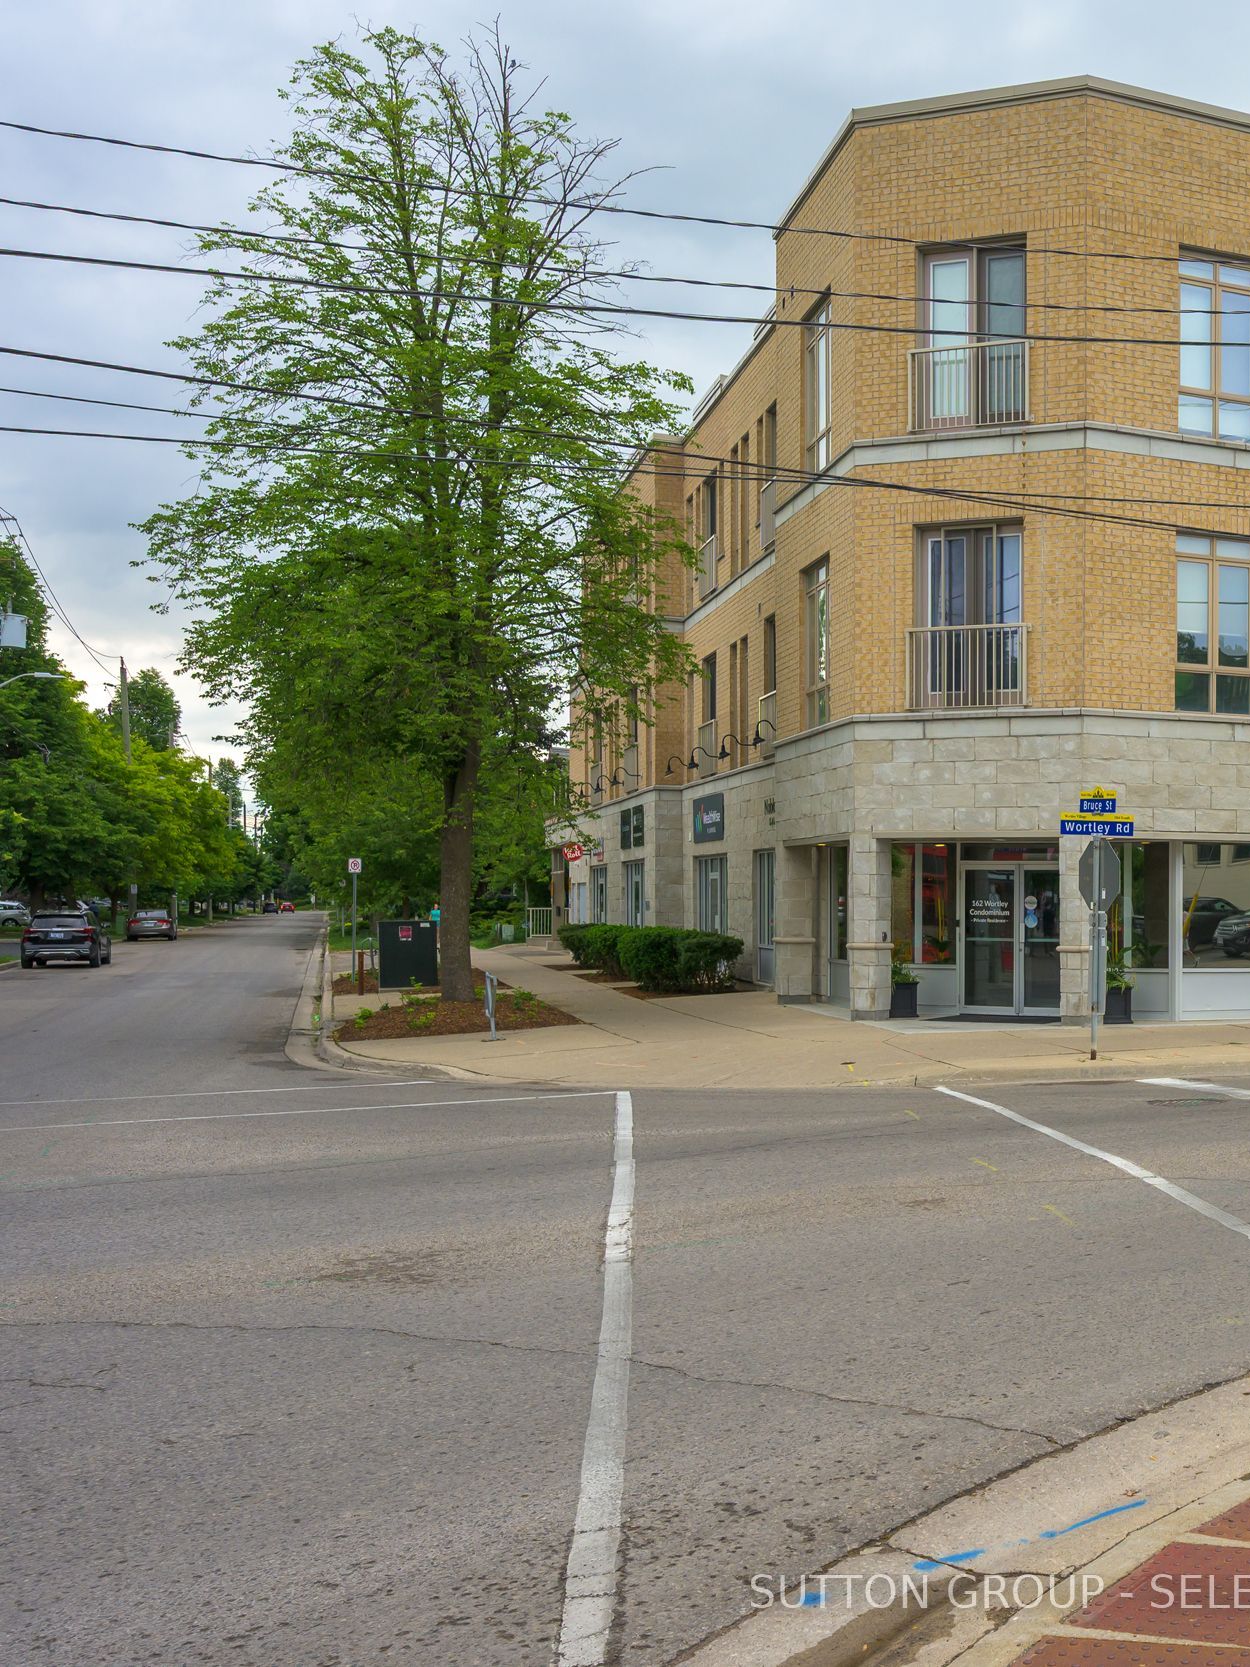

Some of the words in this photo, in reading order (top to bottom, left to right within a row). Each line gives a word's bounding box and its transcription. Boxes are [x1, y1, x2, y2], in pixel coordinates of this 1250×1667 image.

[1083, 800, 1103, 810] Bruce
[1105, 800, 1113, 810] St
[1064, 821, 1111, 835] Wortley
[1116, 823, 1130, 833] Rd
[984, 900, 1009, 908] Wortley
